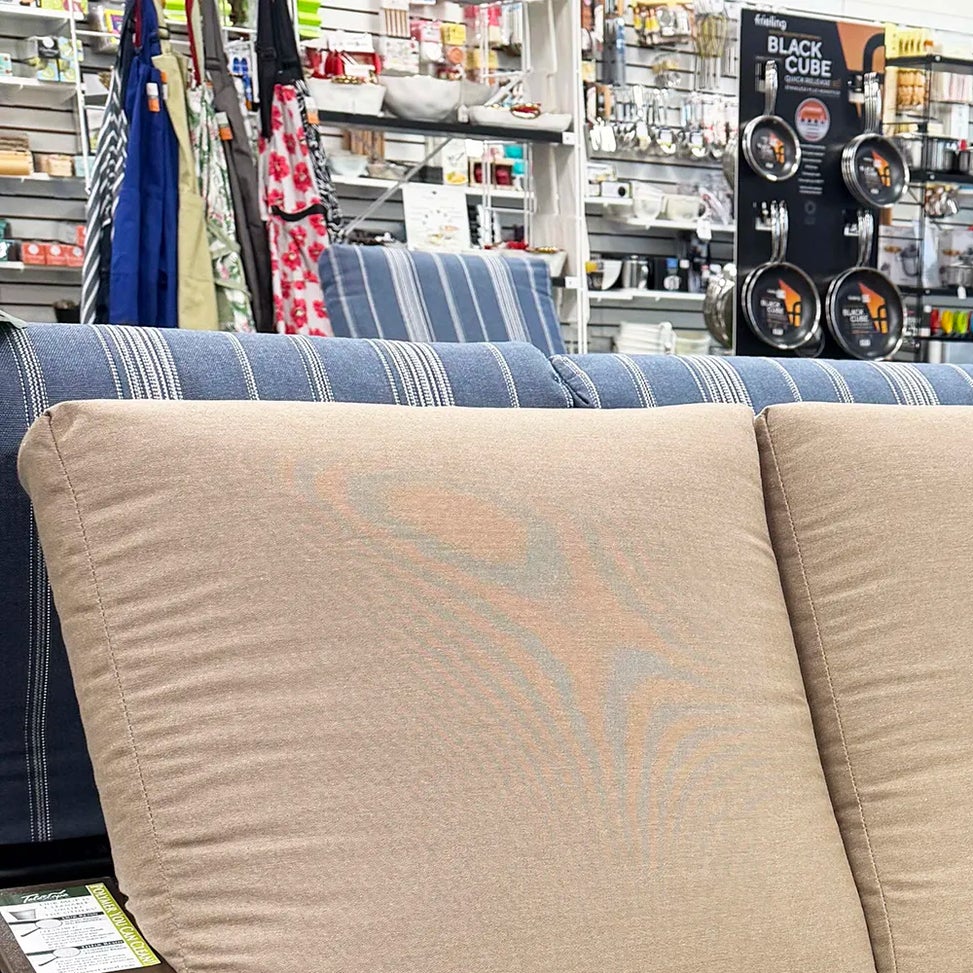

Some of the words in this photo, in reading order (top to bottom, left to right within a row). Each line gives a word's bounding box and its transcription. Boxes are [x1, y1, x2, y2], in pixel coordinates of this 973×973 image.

[754, 14, 787, 31] frieling
[767, 35, 822, 58] BLACK
[785, 55, 832, 77] CUBE
[91, 885, 115, 912] POLYMER
[110, 911, 127, 927] YOU
[120, 926, 138, 942] CAN
[131, 941, 156, 965] CLEAN
